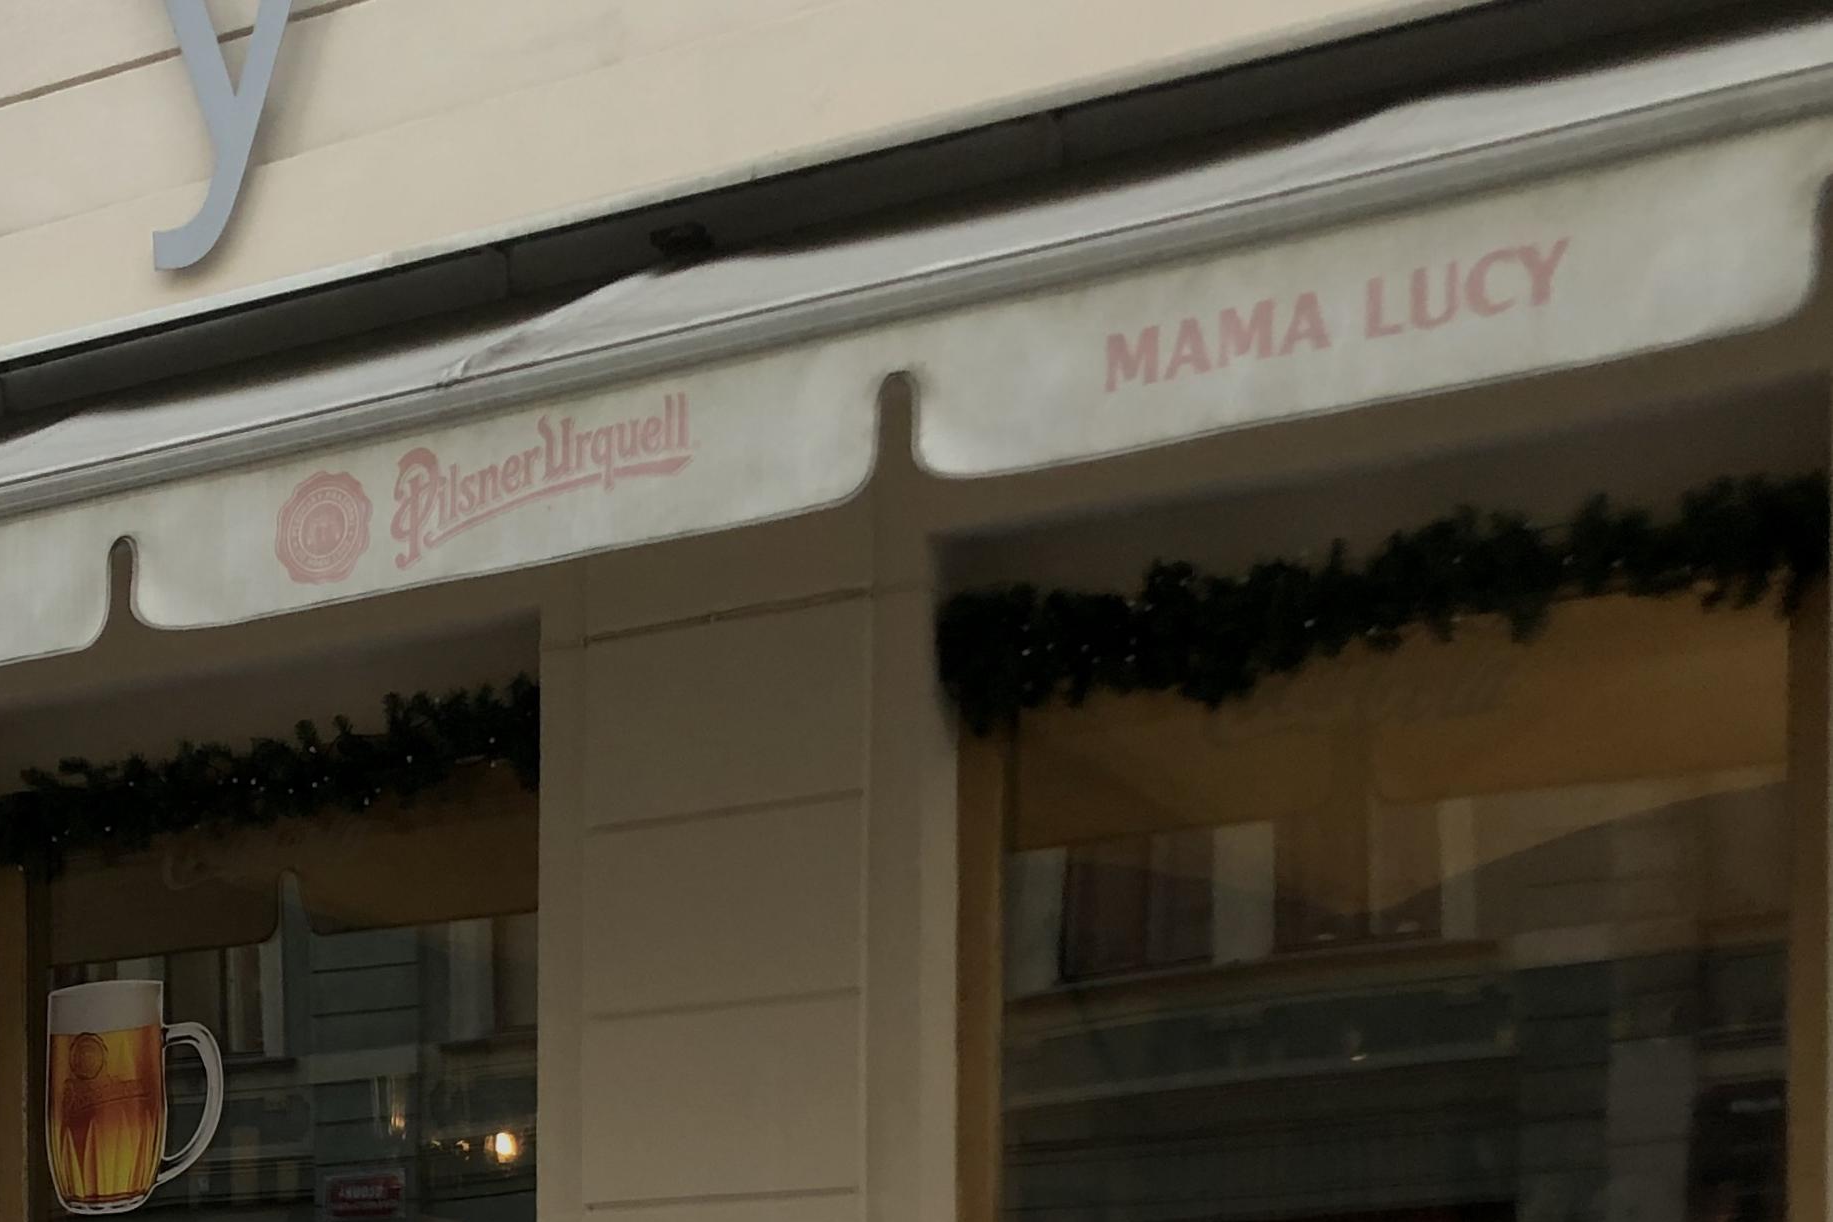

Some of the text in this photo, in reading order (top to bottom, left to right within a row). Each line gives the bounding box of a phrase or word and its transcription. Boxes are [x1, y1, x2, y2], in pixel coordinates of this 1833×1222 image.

[1104, 236, 1571, 393] MAMA LUCY
[390, 446, 544, 571] Pilsner
[537, 390, 692, 492] Urquell
